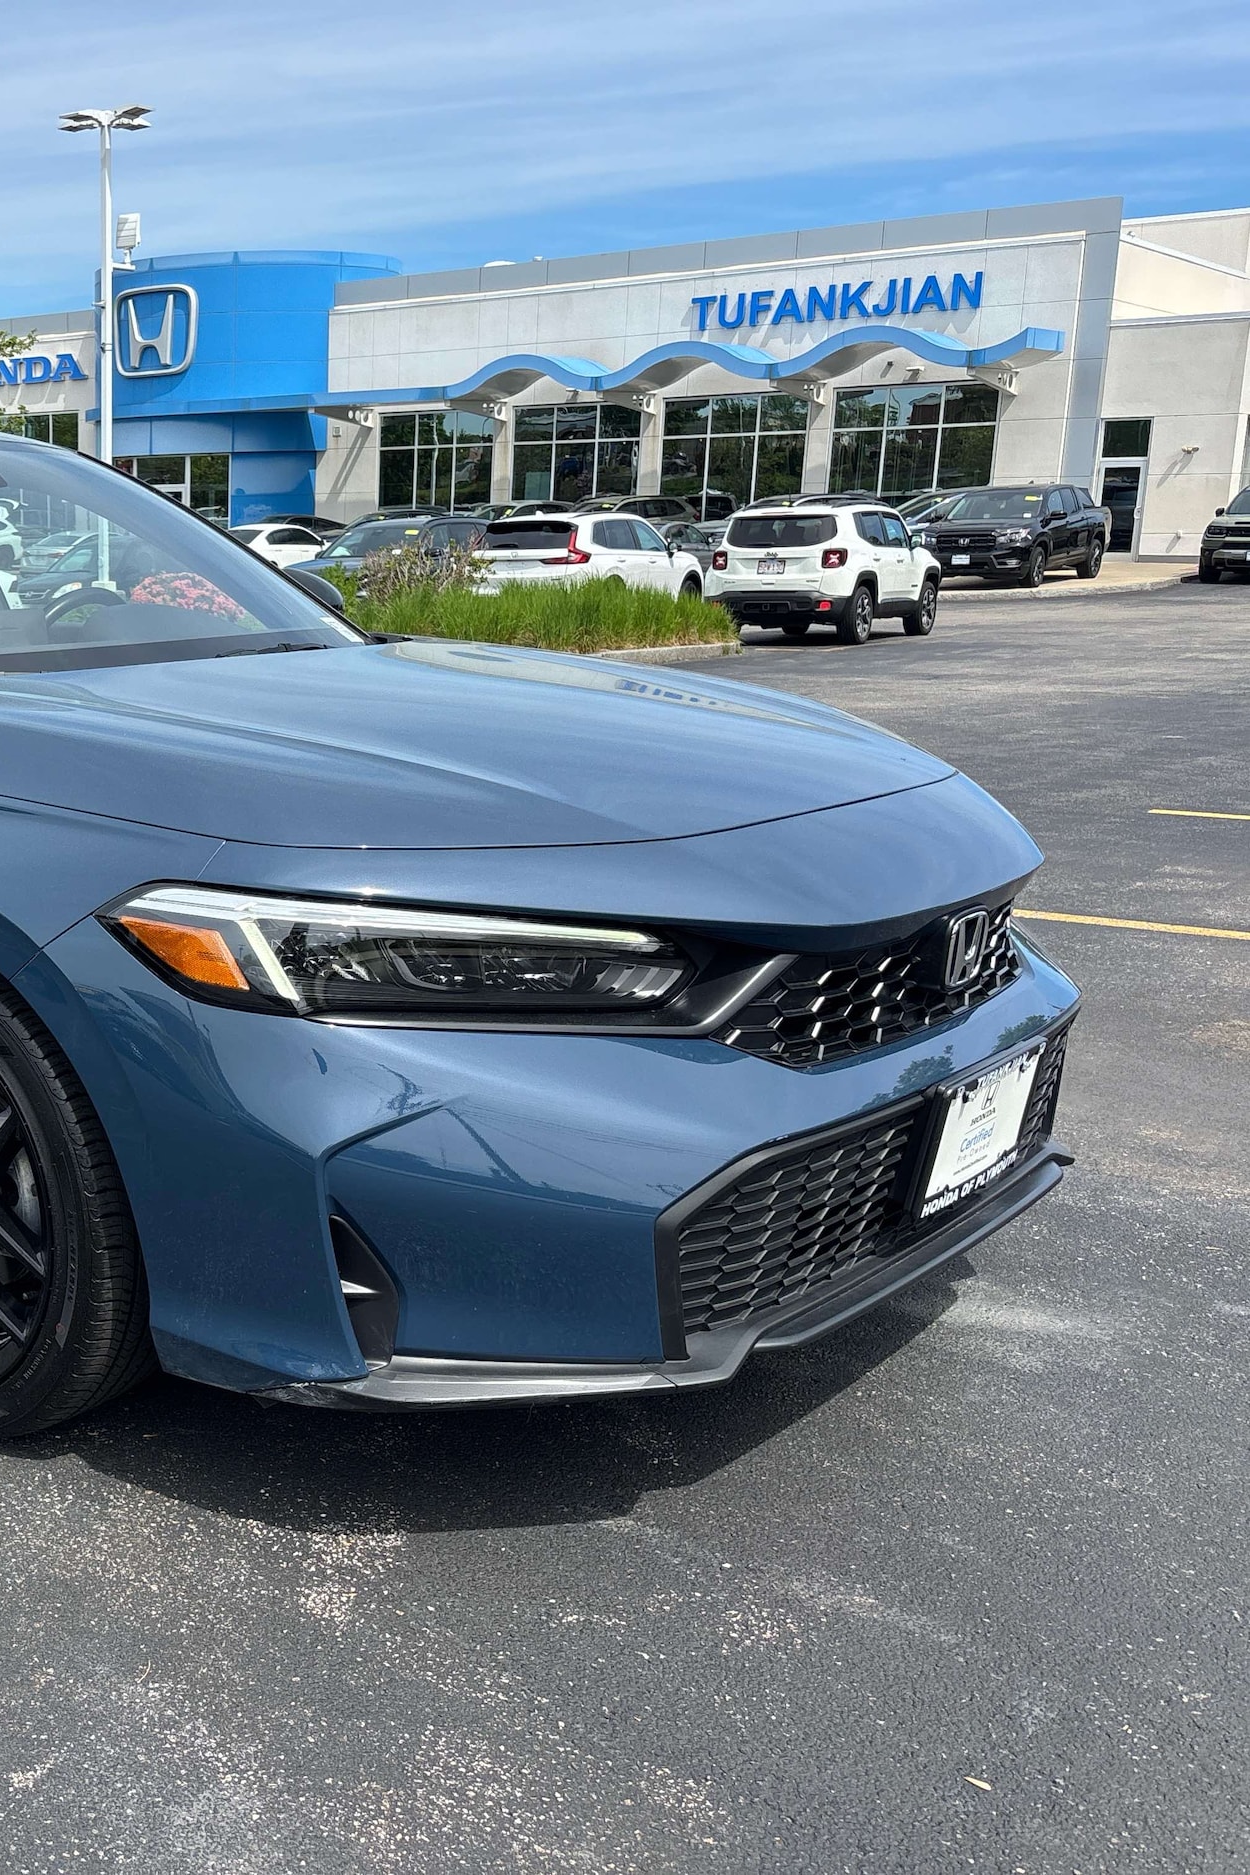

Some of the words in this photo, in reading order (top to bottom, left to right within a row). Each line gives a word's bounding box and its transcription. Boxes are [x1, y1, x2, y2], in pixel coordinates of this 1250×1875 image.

[691, 271, 984, 331] TUFANKJIAN
[959, 1122, 996, 1152] Certified
[969, 1107, 996, 1126] HONDA
[920, 1188, 960, 1218] HONDA
[960, 1179, 977, 1198] OF
[974, 1148, 1019, 1190] PLYMOUTH
